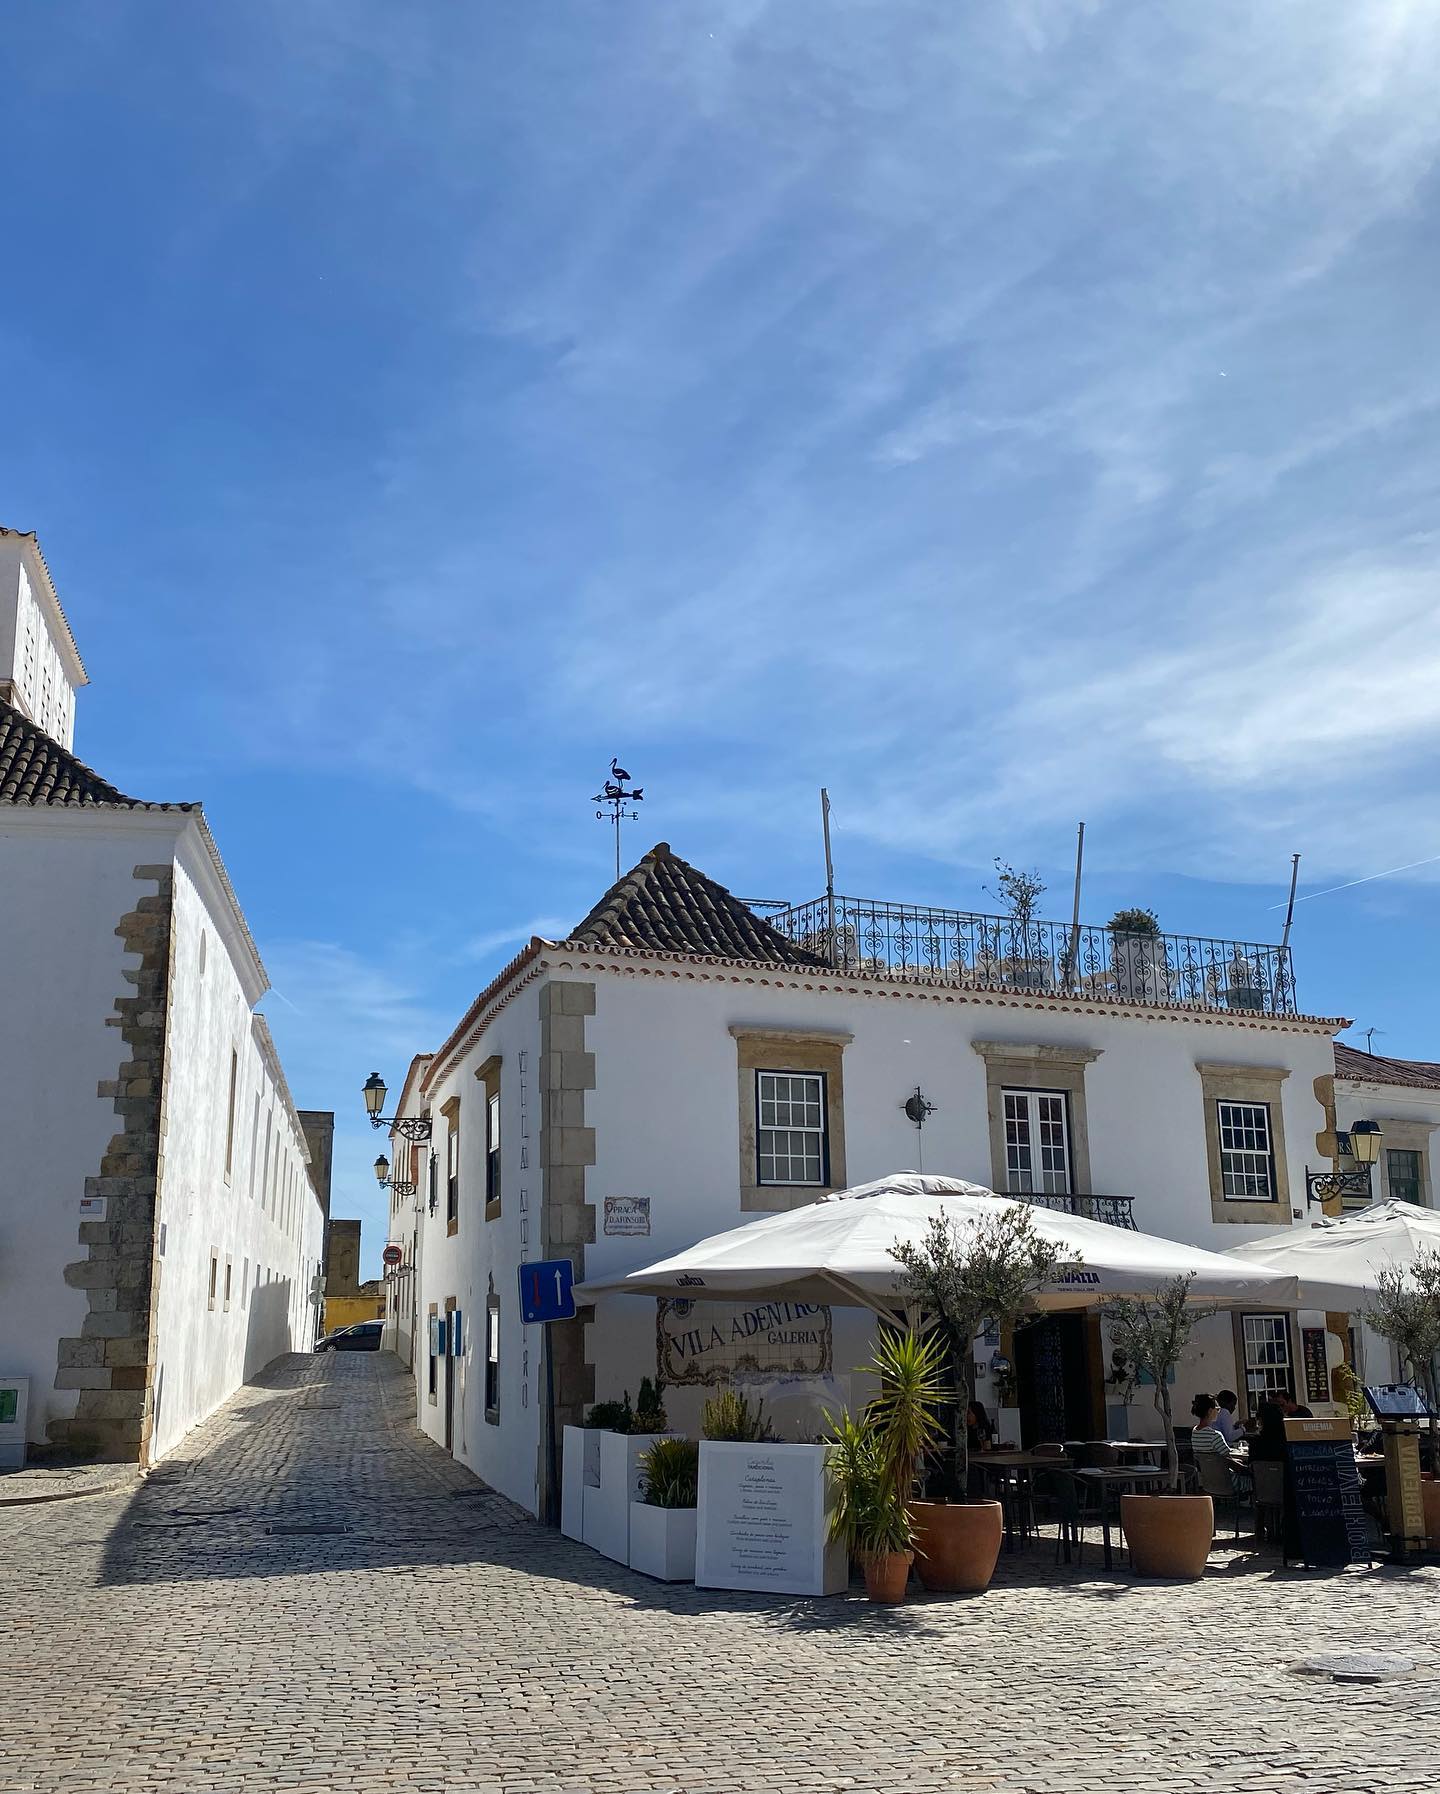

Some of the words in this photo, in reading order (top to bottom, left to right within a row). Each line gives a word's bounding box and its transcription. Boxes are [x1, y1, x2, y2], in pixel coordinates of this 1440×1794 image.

[670, 1324, 726, 1360] VILA
[731, 1302, 821, 1343] ADENTRO
[768, 1331, 818, 1345] GALERIA
[1303, 1422, 1334, 1432] BOHEMIA
[1334, 1442, 1371, 1564] BOHEMIA
[1400, 1444, 1423, 1528] BOHEMIA
